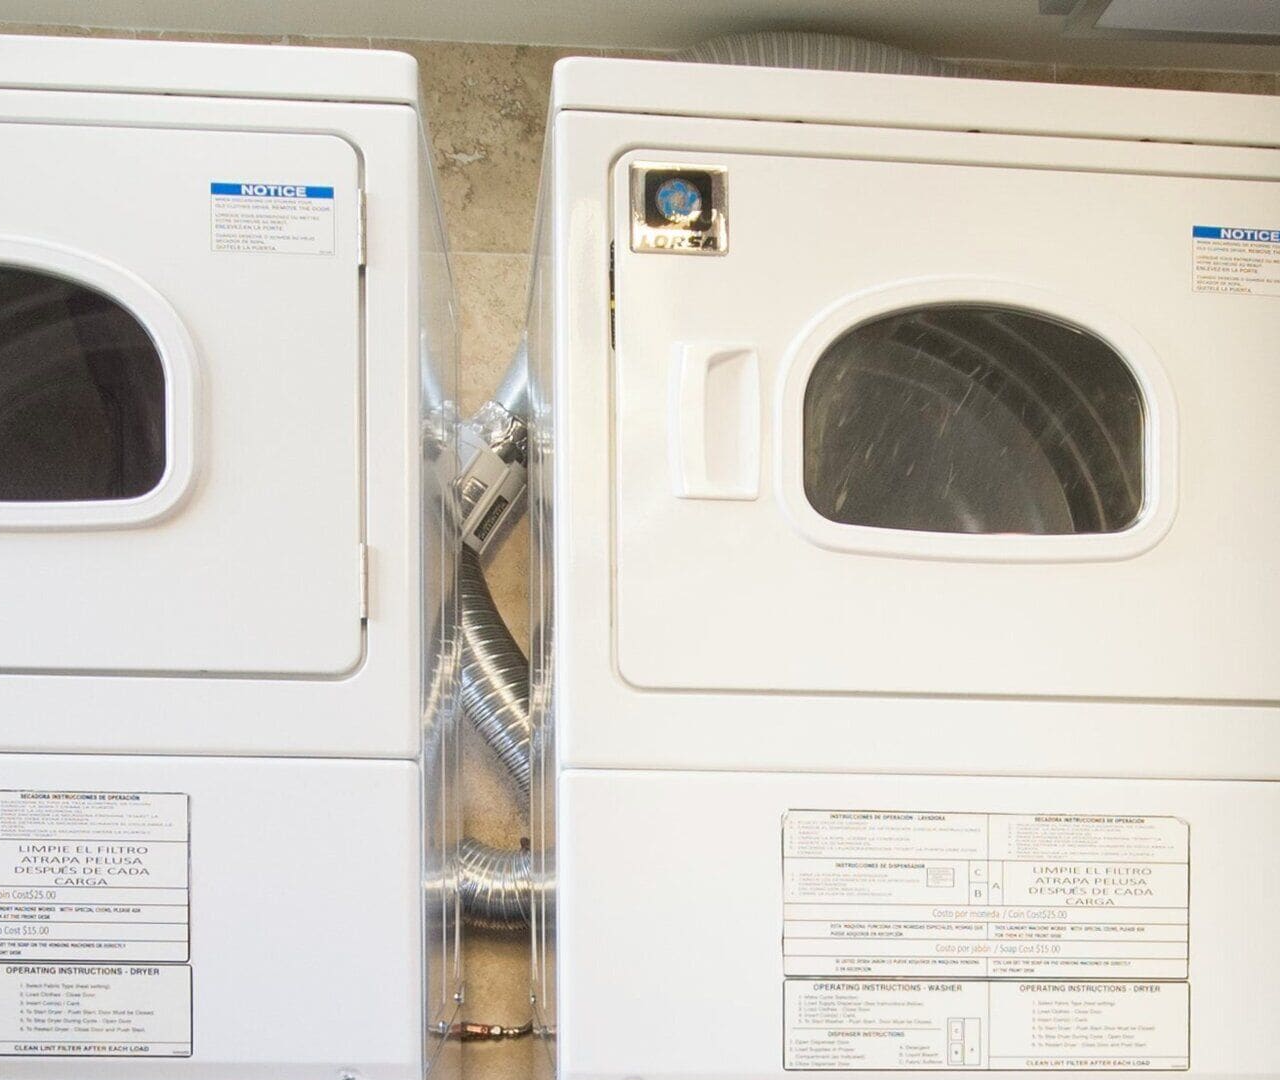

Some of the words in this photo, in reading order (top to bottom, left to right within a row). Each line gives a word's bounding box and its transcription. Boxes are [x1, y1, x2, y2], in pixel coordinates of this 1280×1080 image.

[241, 184, 307, 197] NOTICE
[1220, 228, 1280, 241] NOTICE
[19, 845, 71, 853] LIMPIE
[76, 846, 92, 854] EL
[98, 846, 148, 854] FILTRO
[21, 856, 80, 864] ATRAPA
[86, 857, 143, 865] PELUSA
[14, 865, 76, 874] DESPUÉS
[83, 867, 105, 875] DE
[1033, 866, 1081, 874] LIMPIE
[1086, 867, 1101, 875] EL
[1105, 867, 1152, 875] FILTRO
[54, 877, 108, 885] CARGA
[1035, 877, 1089, 885] ATRAPA
[1094, 878, 1147, 886] PELUSA
[974, 890, 981, 898] B
[1029, 885, 1087, 895] DESPUÉS
[1092, 887, 1109, 895] DE
[1114, 888, 1153, 896] CADA
[932, 909, 953, 918] Costo
[955, 911, 968, 920] por
[970, 910, 999, 918] moneda
[1008, 910, 1024, 919] Coin
[4, 926, 20, 935] Cost
[22, 926, 49, 936] $15.00
[935, 944, 955, 952] Costo
[957, 946, 969, 954] por
[1000, 944, 1017, 954] Soap
[1019, 944, 1034, 953] Cost
[1036, 944, 1060, 954] $15.00
[58, 967, 122, 975] INSTRUCTIONS
[862, 984, 921, 992] INSTRUCTIONS
[928, 984, 963, 992] WASHER
[1068, 985, 1127, 993] INSTRUCTIONS
[1133, 985, 1160, 993] DRYER
